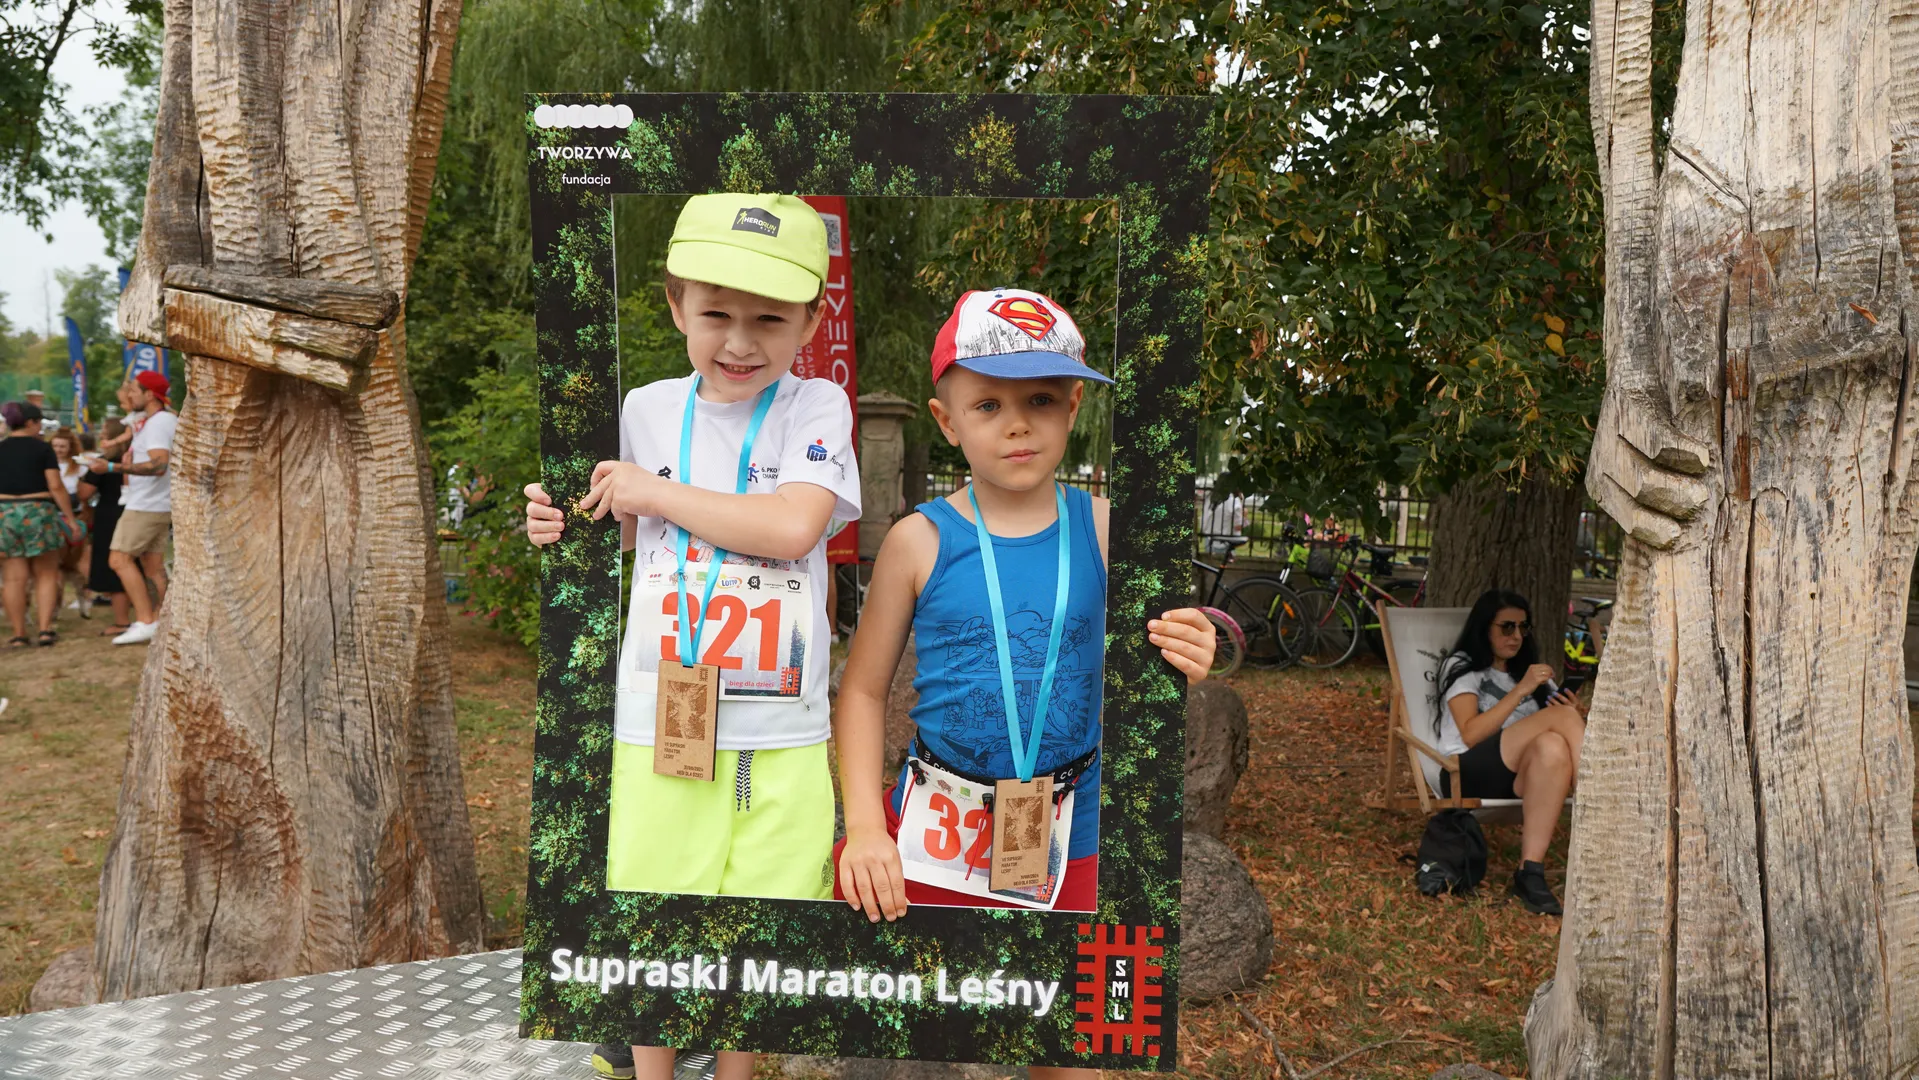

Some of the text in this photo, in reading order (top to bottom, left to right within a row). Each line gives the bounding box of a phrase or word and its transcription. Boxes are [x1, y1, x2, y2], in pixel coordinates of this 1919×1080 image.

[537, 146, 633, 160] TWORZYWA
[561, 173, 611, 187] fundacja
[721, 579, 738, 587] LOTTO
[660, 592, 782, 671] 321
[729, 680, 744, 688] bieg
[551, 947, 1060, 1017] Supraski Maraton Leśny
